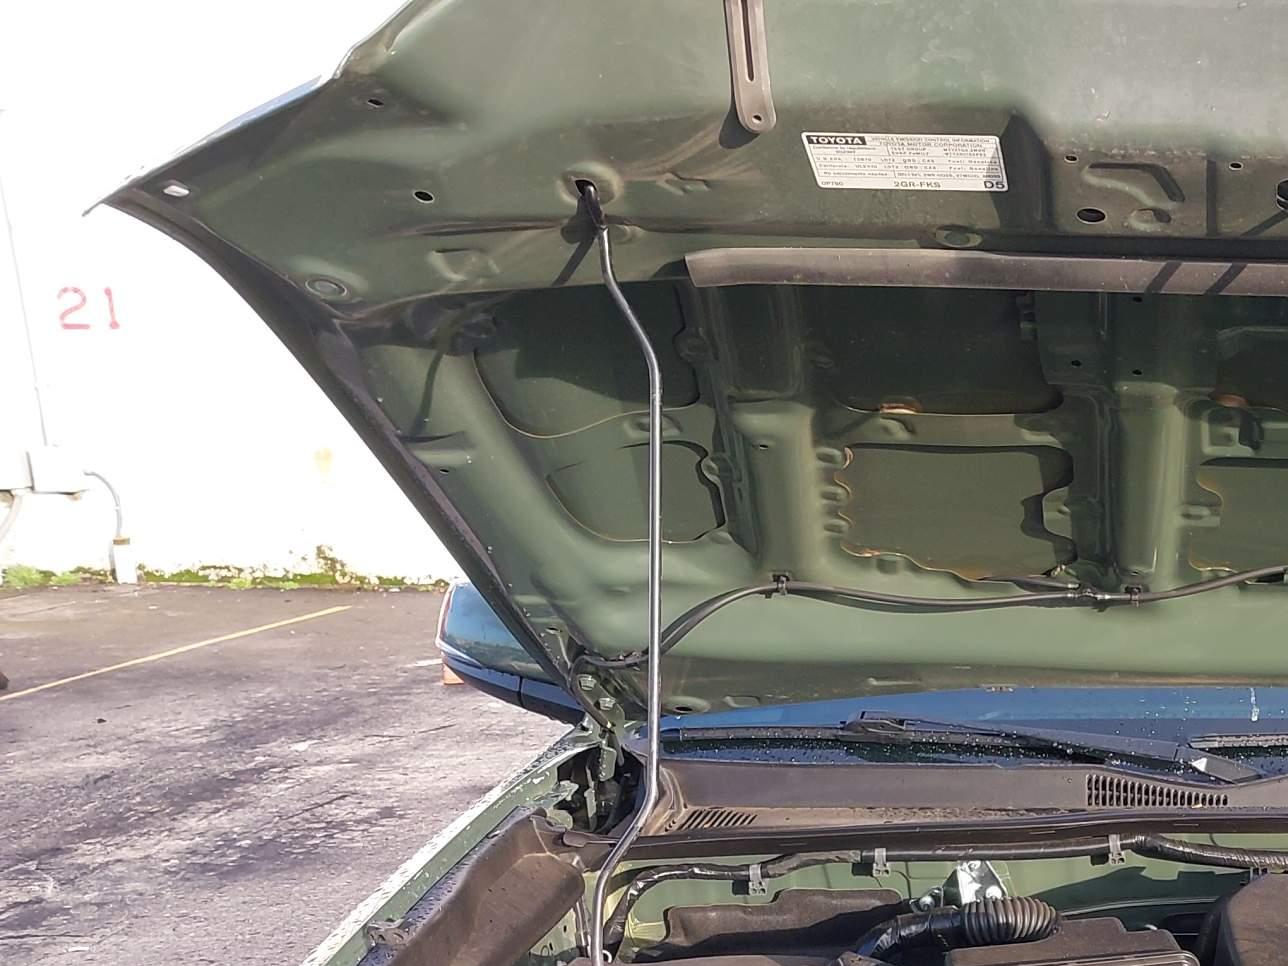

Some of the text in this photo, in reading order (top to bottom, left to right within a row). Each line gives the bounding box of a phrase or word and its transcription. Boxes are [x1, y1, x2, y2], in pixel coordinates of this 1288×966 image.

[809, 136, 863, 145] TOYOTA
[983, 180, 1006, 190] D5
[56, 286, 121, 331] 21
